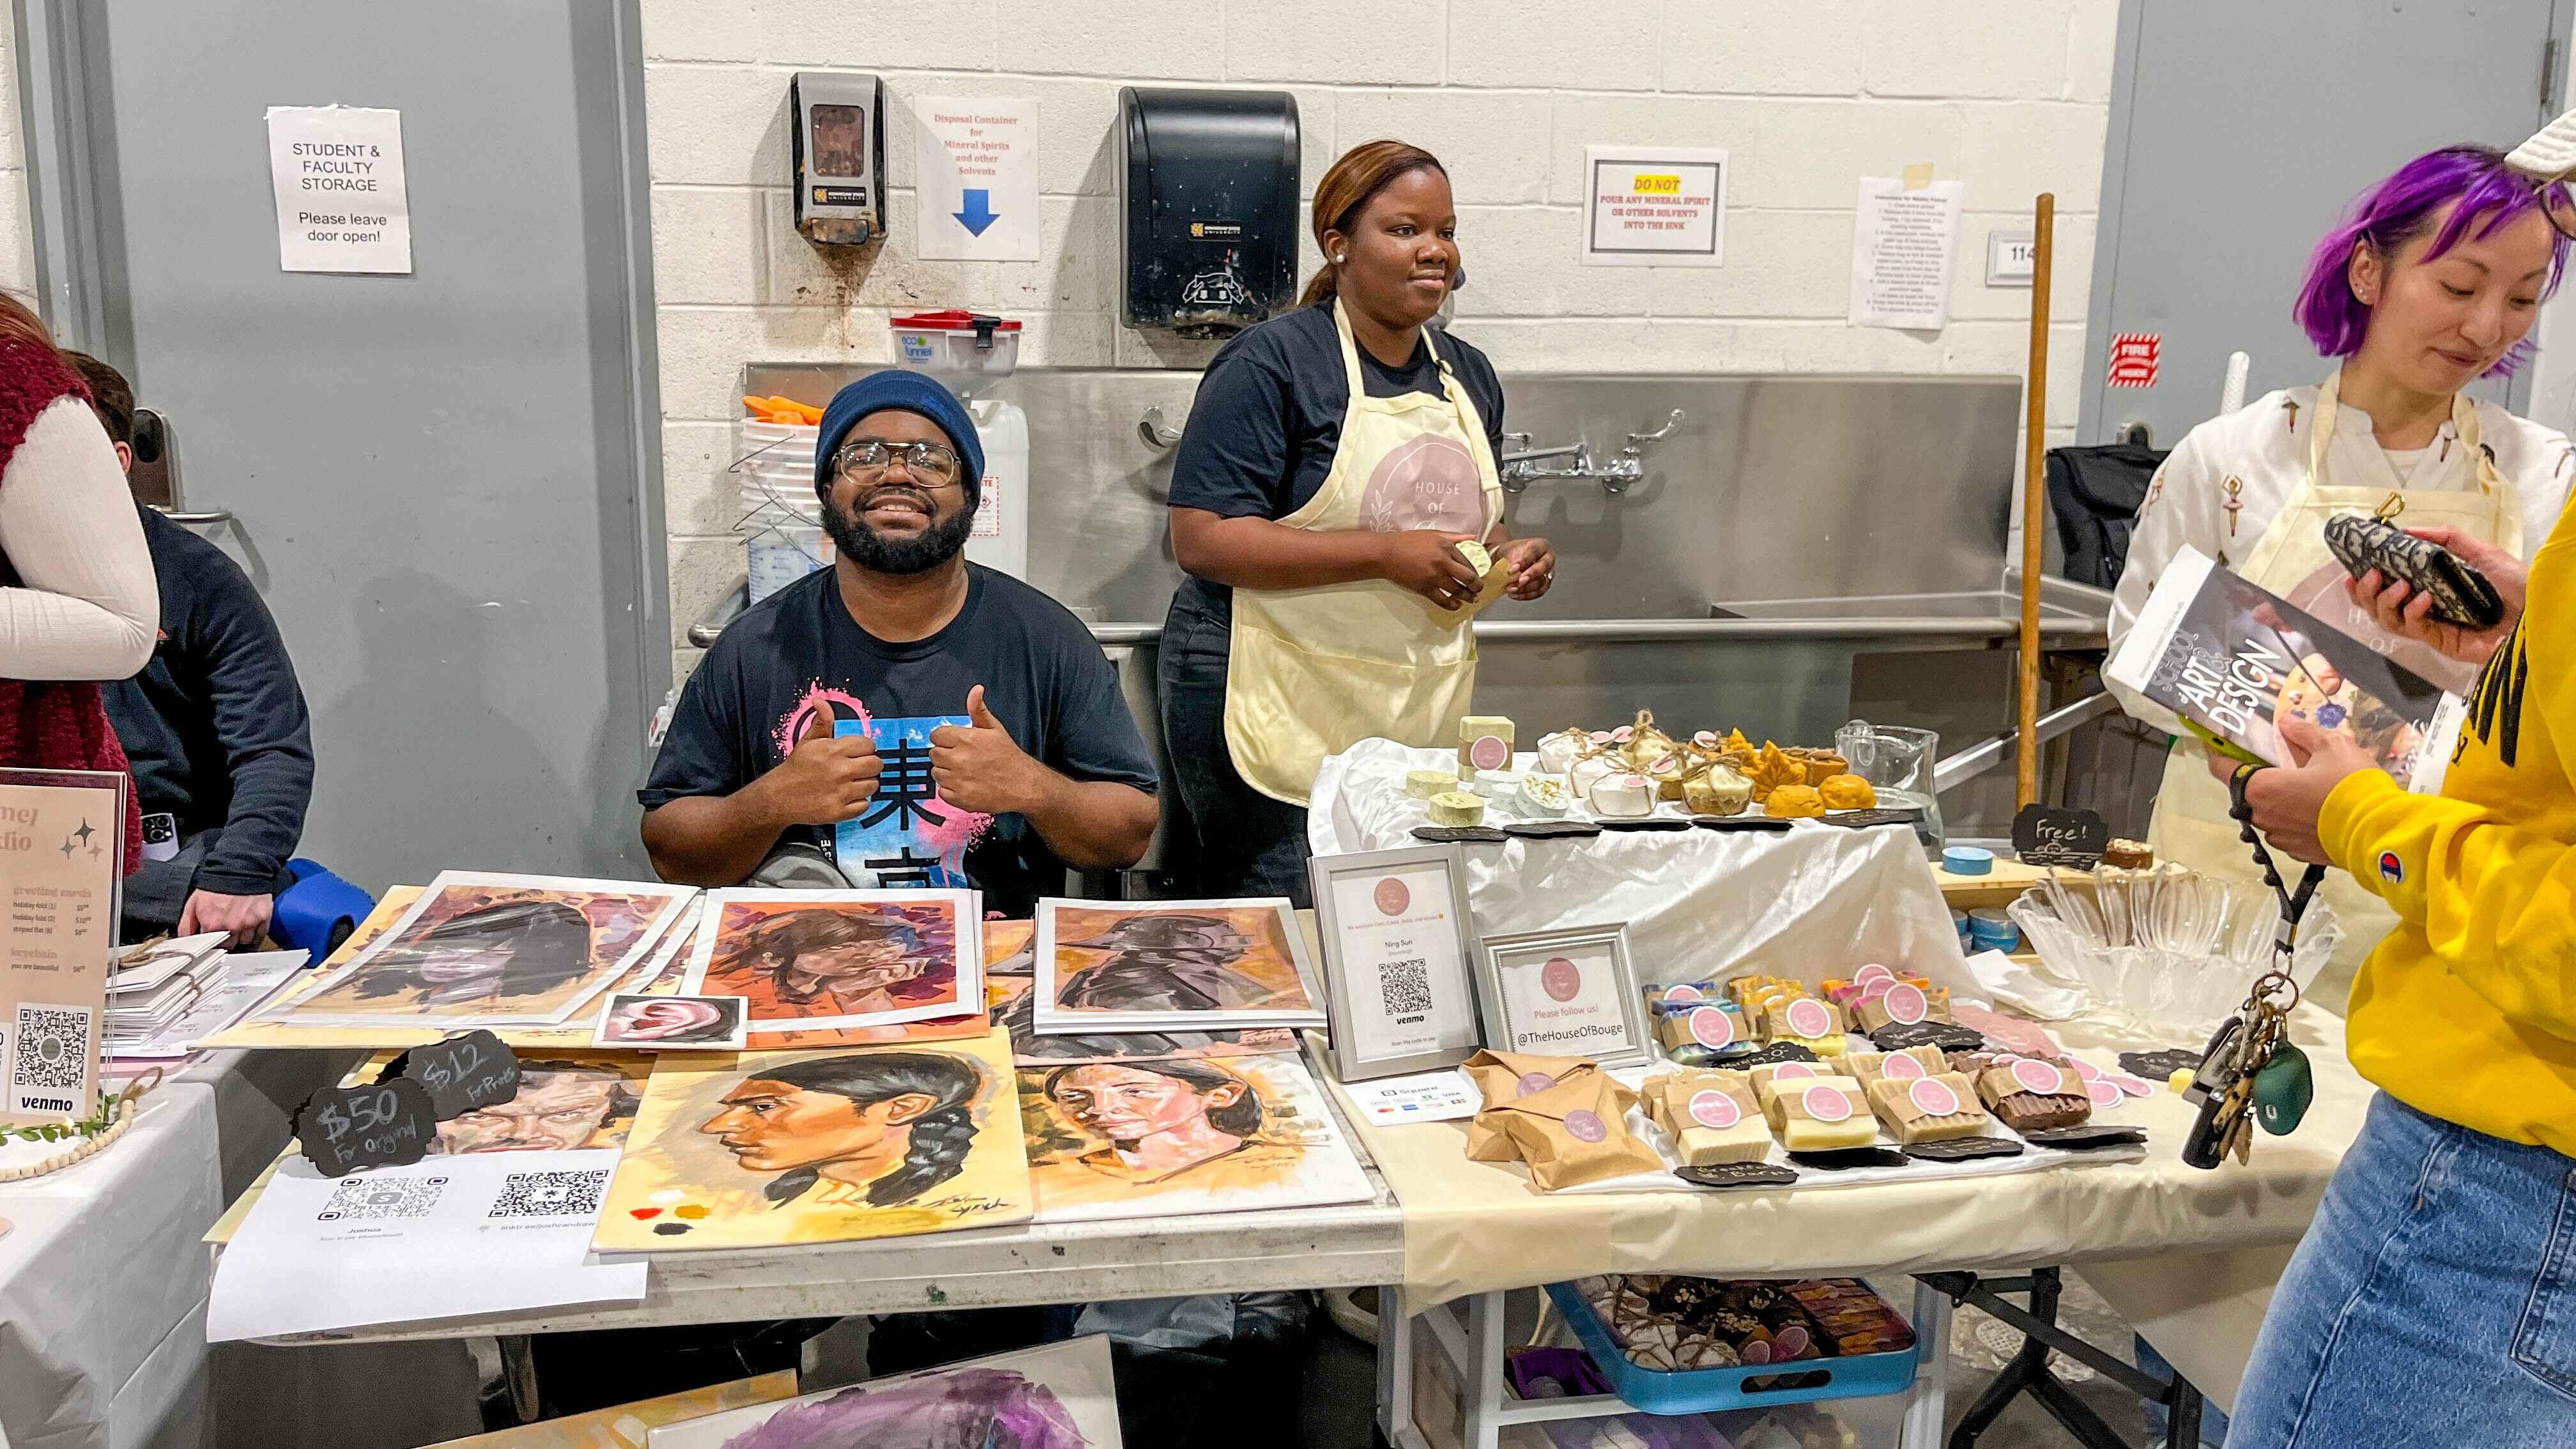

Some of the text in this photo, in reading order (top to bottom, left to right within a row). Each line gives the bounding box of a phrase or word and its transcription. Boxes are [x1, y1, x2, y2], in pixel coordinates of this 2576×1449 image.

[934, 114, 1018, 125] Disposal Container
[970, 128, 983, 137] for
[293, 143, 380, 157] STUDENT &
[944, 141, 1010, 151] Mineral Spirits
[955, 154, 998, 162] and other
[303, 161, 372, 174] FACULTY
[958, 166, 995, 175] Solvents
[302, 178, 377, 191] STORAGE
[1634, 179, 1680, 191] DO NOT
[1600, 195, 1711, 206] POUR ANY MINERAL SPIRIT
[299, 212, 387, 226] Please leave
[1612, 208, 1698, 218] OR OTHER SOLVENTS
[1624, 221, 1685, 230] INTO THE SINK
[308, 230, 380, 244] door open!
[2121, 344, 2149, 356] FIRE
[1414, 482, 1461, 496] HOUSE
[1428, 502, 1446, 514] OF
[2176, 655, 2224, 714] ART
[2208, 638, 2281, 736] DESIGN
[2035, 818, 2087, 840] Free!
[13, 901, 34, 910] holiday
[13, 914, 34, 923] holiday
[1384, 940, 1400, 949] Ning
[1534, 1003, 1599, 1020] Please follow us!
[1397, 1015, 1424, 1025] venmo
[1517, 1024, 1623, 1046] @TheHouseOfBouge
[423, 1043, 490, 1091] $12
[1399, 1086, 1439, 1094] Square
[21, 1097, 73, 1112] venmo
[317, 1089, 399, 1144] $50
